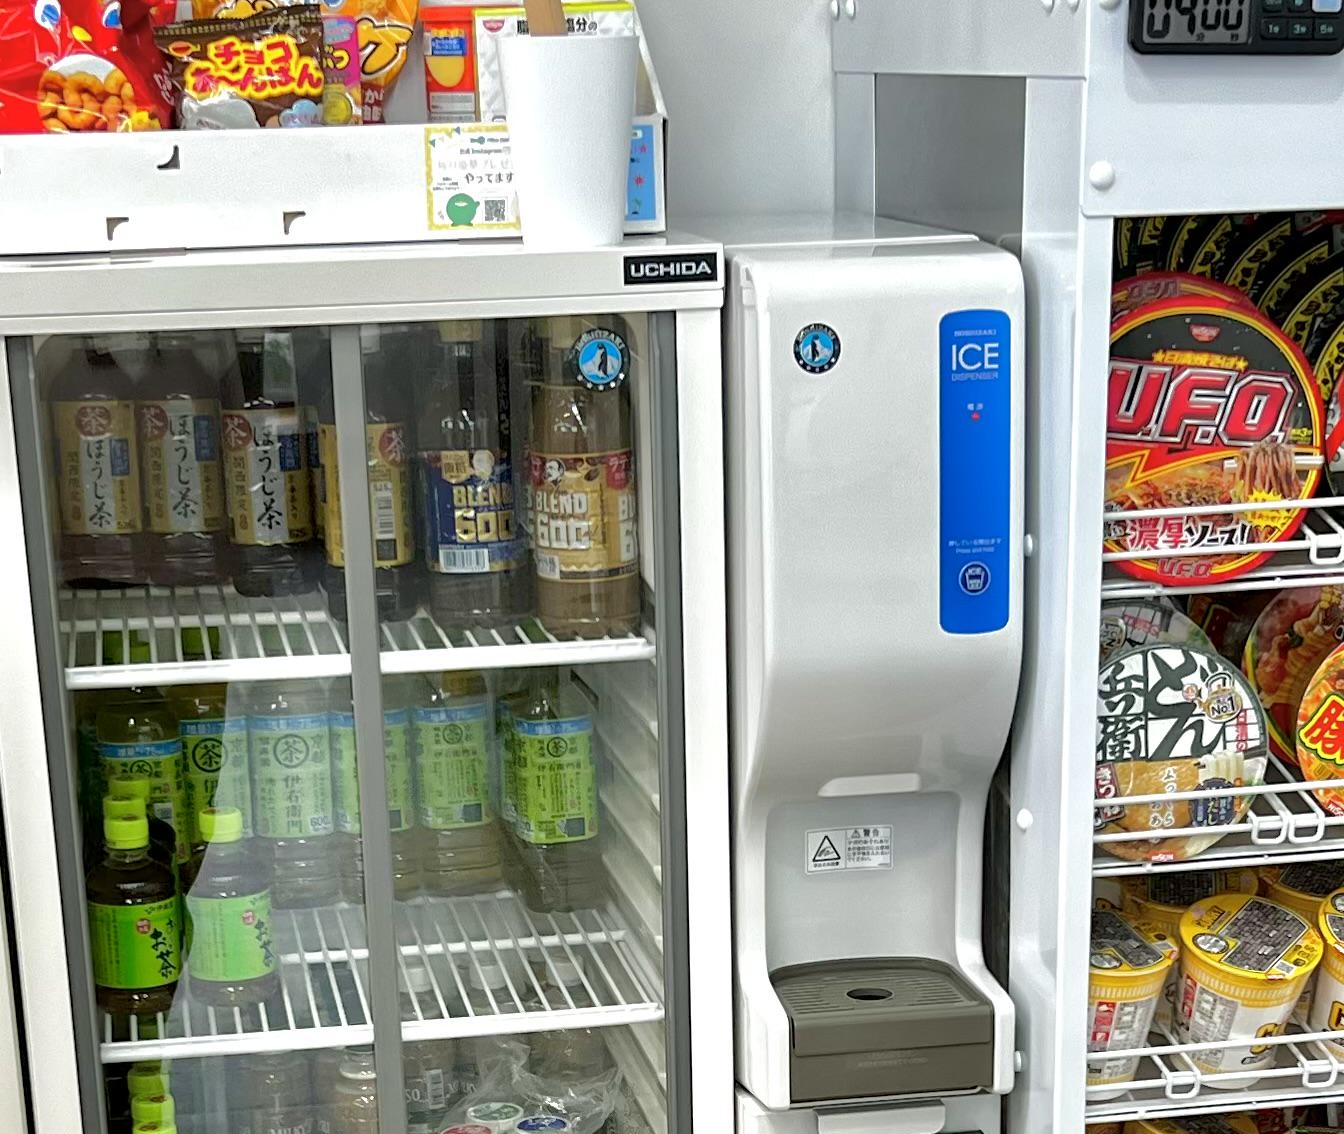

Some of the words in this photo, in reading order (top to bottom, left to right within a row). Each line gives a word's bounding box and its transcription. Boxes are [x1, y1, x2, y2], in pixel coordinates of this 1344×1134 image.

[210, 38, 294, 67] チョコ
[464, 172, 515, 184] やってます
[630, 261, 712, 277] UCHIDA
[951, 343, 999, 371] ICE
[951, 371, 999, 382] DISPENSER
[168, 413, 198, 519] ほうじ茶
[253, 426, 284, 531] ほうじ茶
[86, 438, 113, 529] ほうじ茶
[536, 490, 590, 515] BLEND
[1098, 659, 1145, 760] 兵衛
[1147, 649, 1223, 760] どん
[1235, 708, 1249, 752] 日清の
[198, 742, 223, 768] 茶
[280, 738, 303, 765] 茶
[285, 774, 303, 834] 伊右衛門
